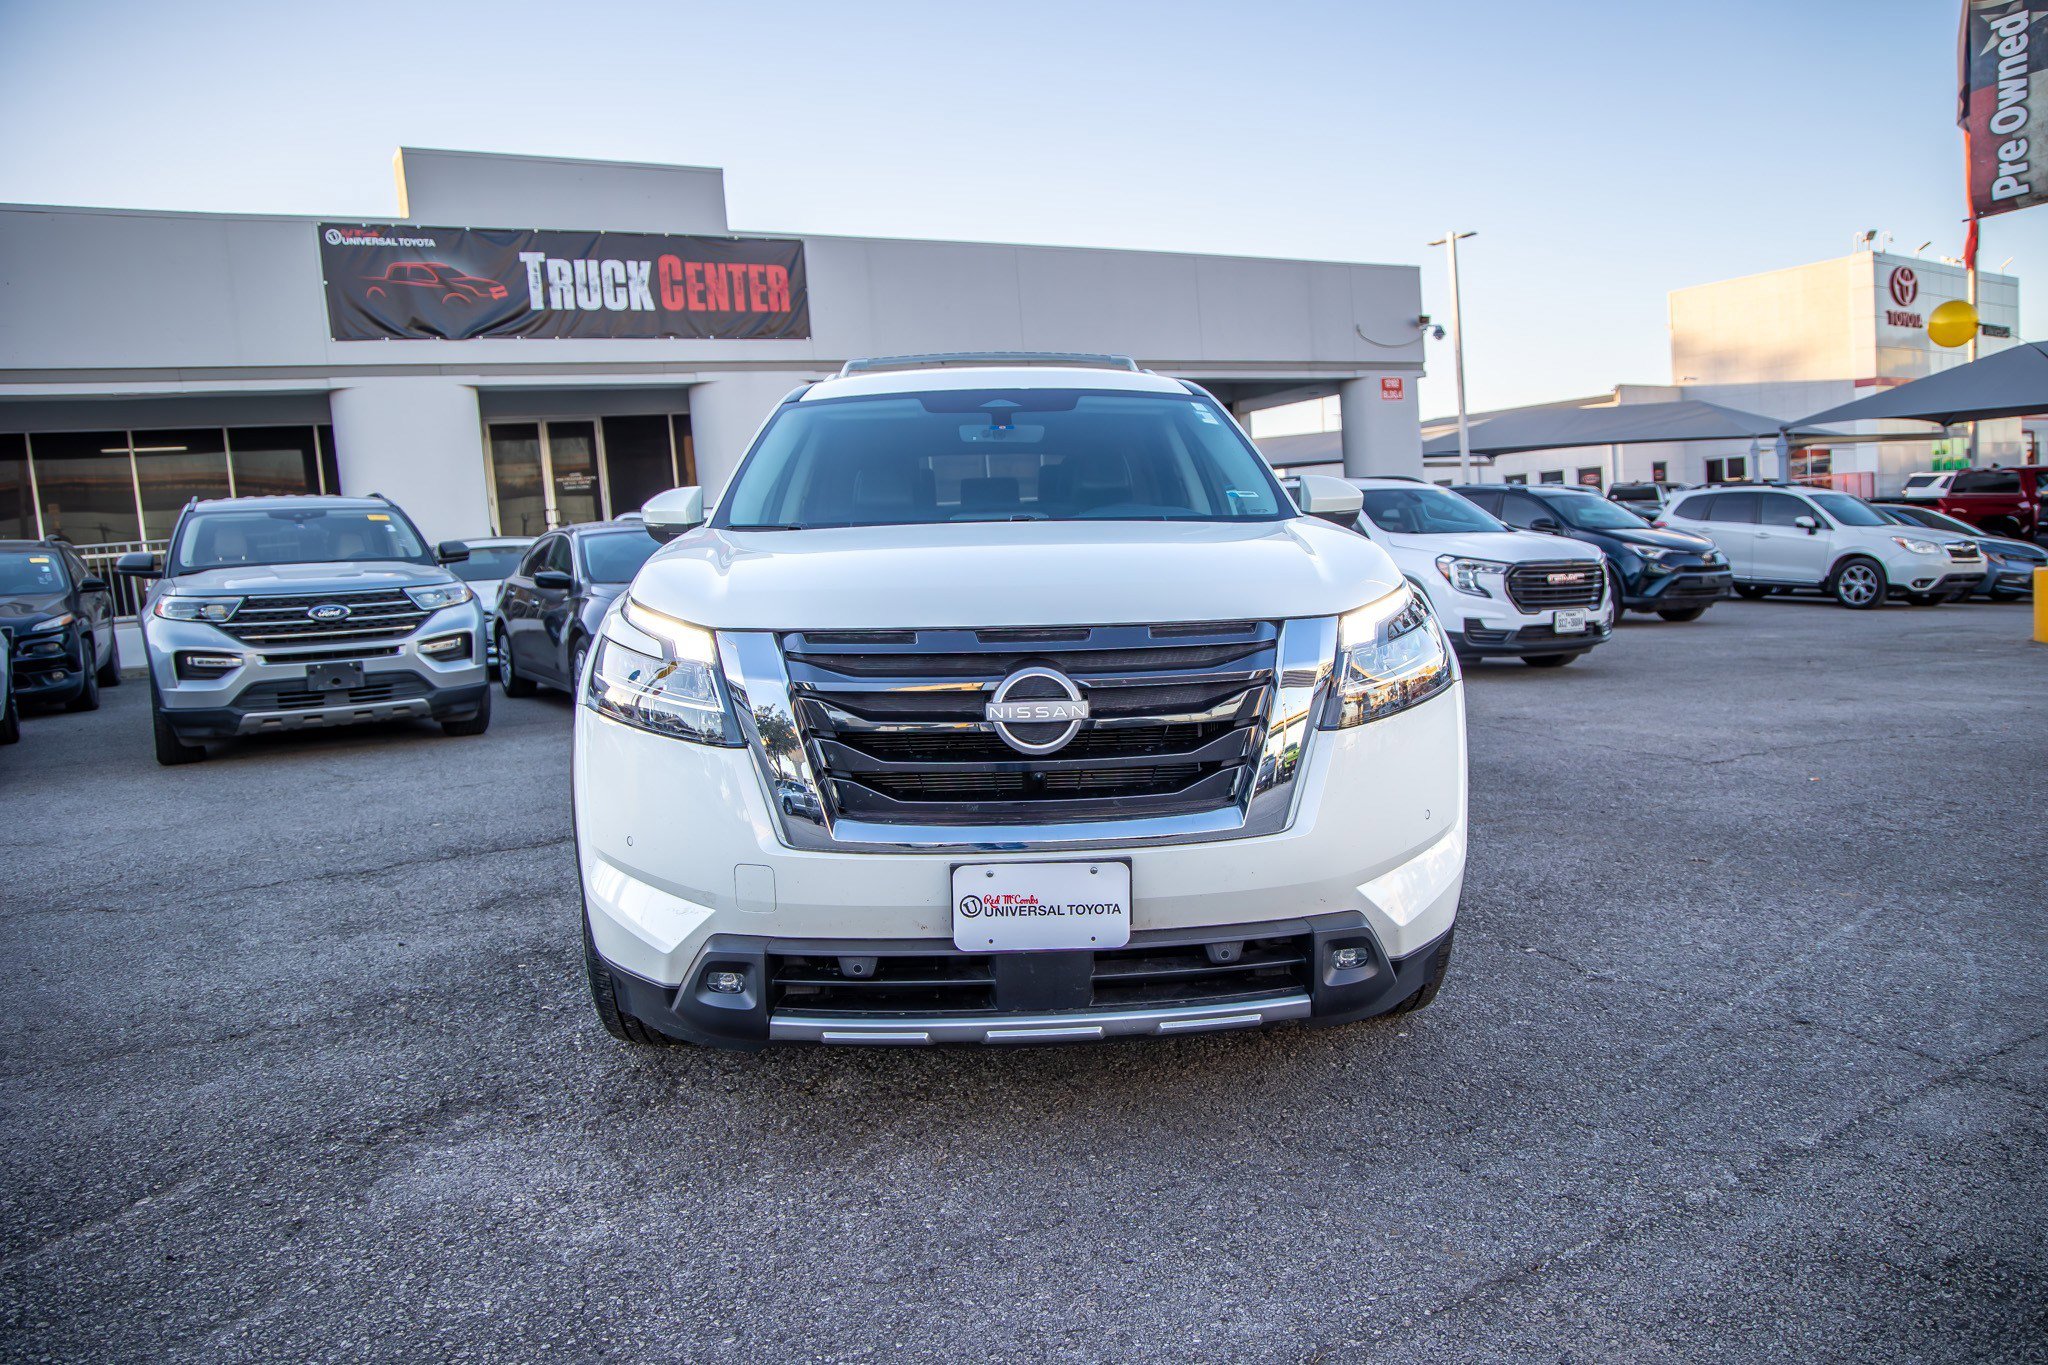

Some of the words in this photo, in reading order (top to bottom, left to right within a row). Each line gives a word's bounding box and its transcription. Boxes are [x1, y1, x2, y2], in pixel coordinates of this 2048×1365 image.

[1990, 9, 2030, 134] Owned
[1991, 137, 2031, 201] Pre
[341, 236, 398, 246] UNIVERSAL
[398, 237, 436, 247] TOYOTA
[989, 704, 1086, 719] NISSAN
[983, 894, 1000, 909] Red
[984, 905, 1065, 917] UNIVERSAL
[1067, 903, 1122, 916] TOYOTA
